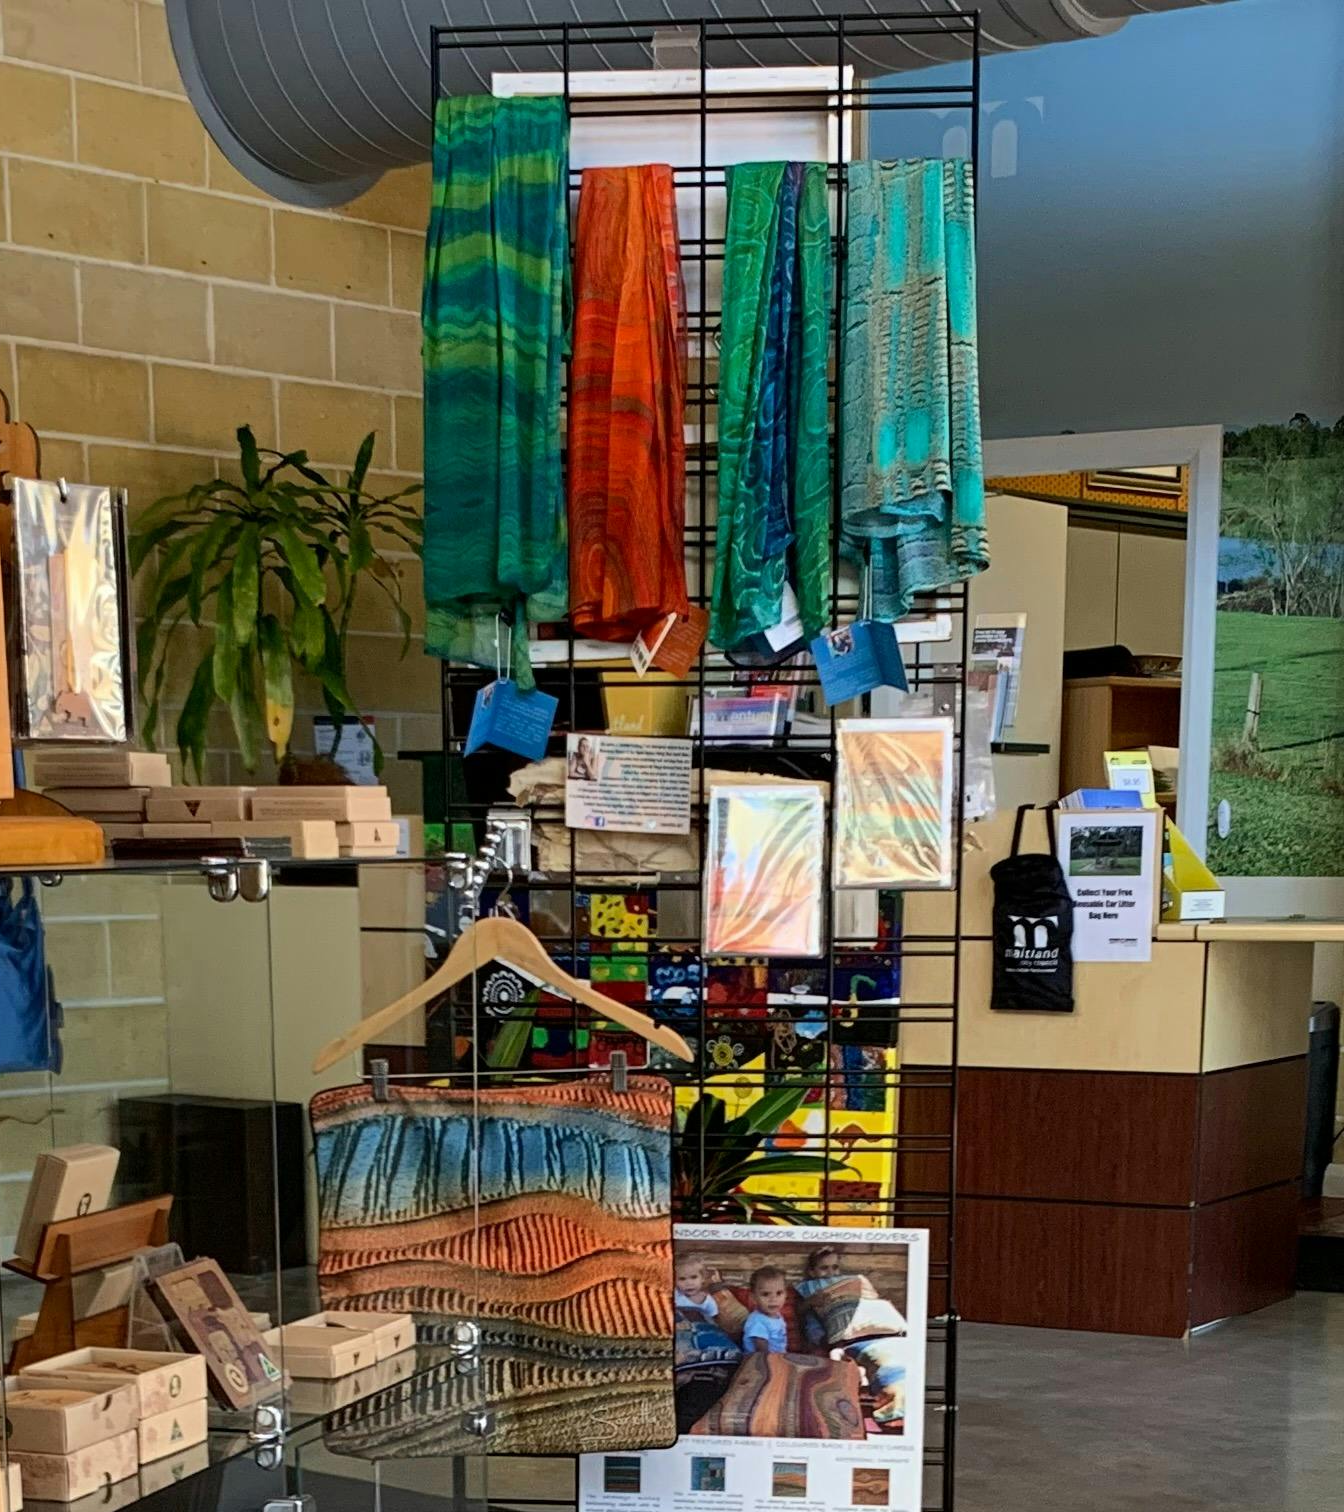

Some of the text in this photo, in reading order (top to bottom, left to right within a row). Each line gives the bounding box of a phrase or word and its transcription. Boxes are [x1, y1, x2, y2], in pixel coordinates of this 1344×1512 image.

[1105, 900, 1118, 908] Car
[731, 1230, 921, 1242] OUTDOOR CUSHION COVERS
